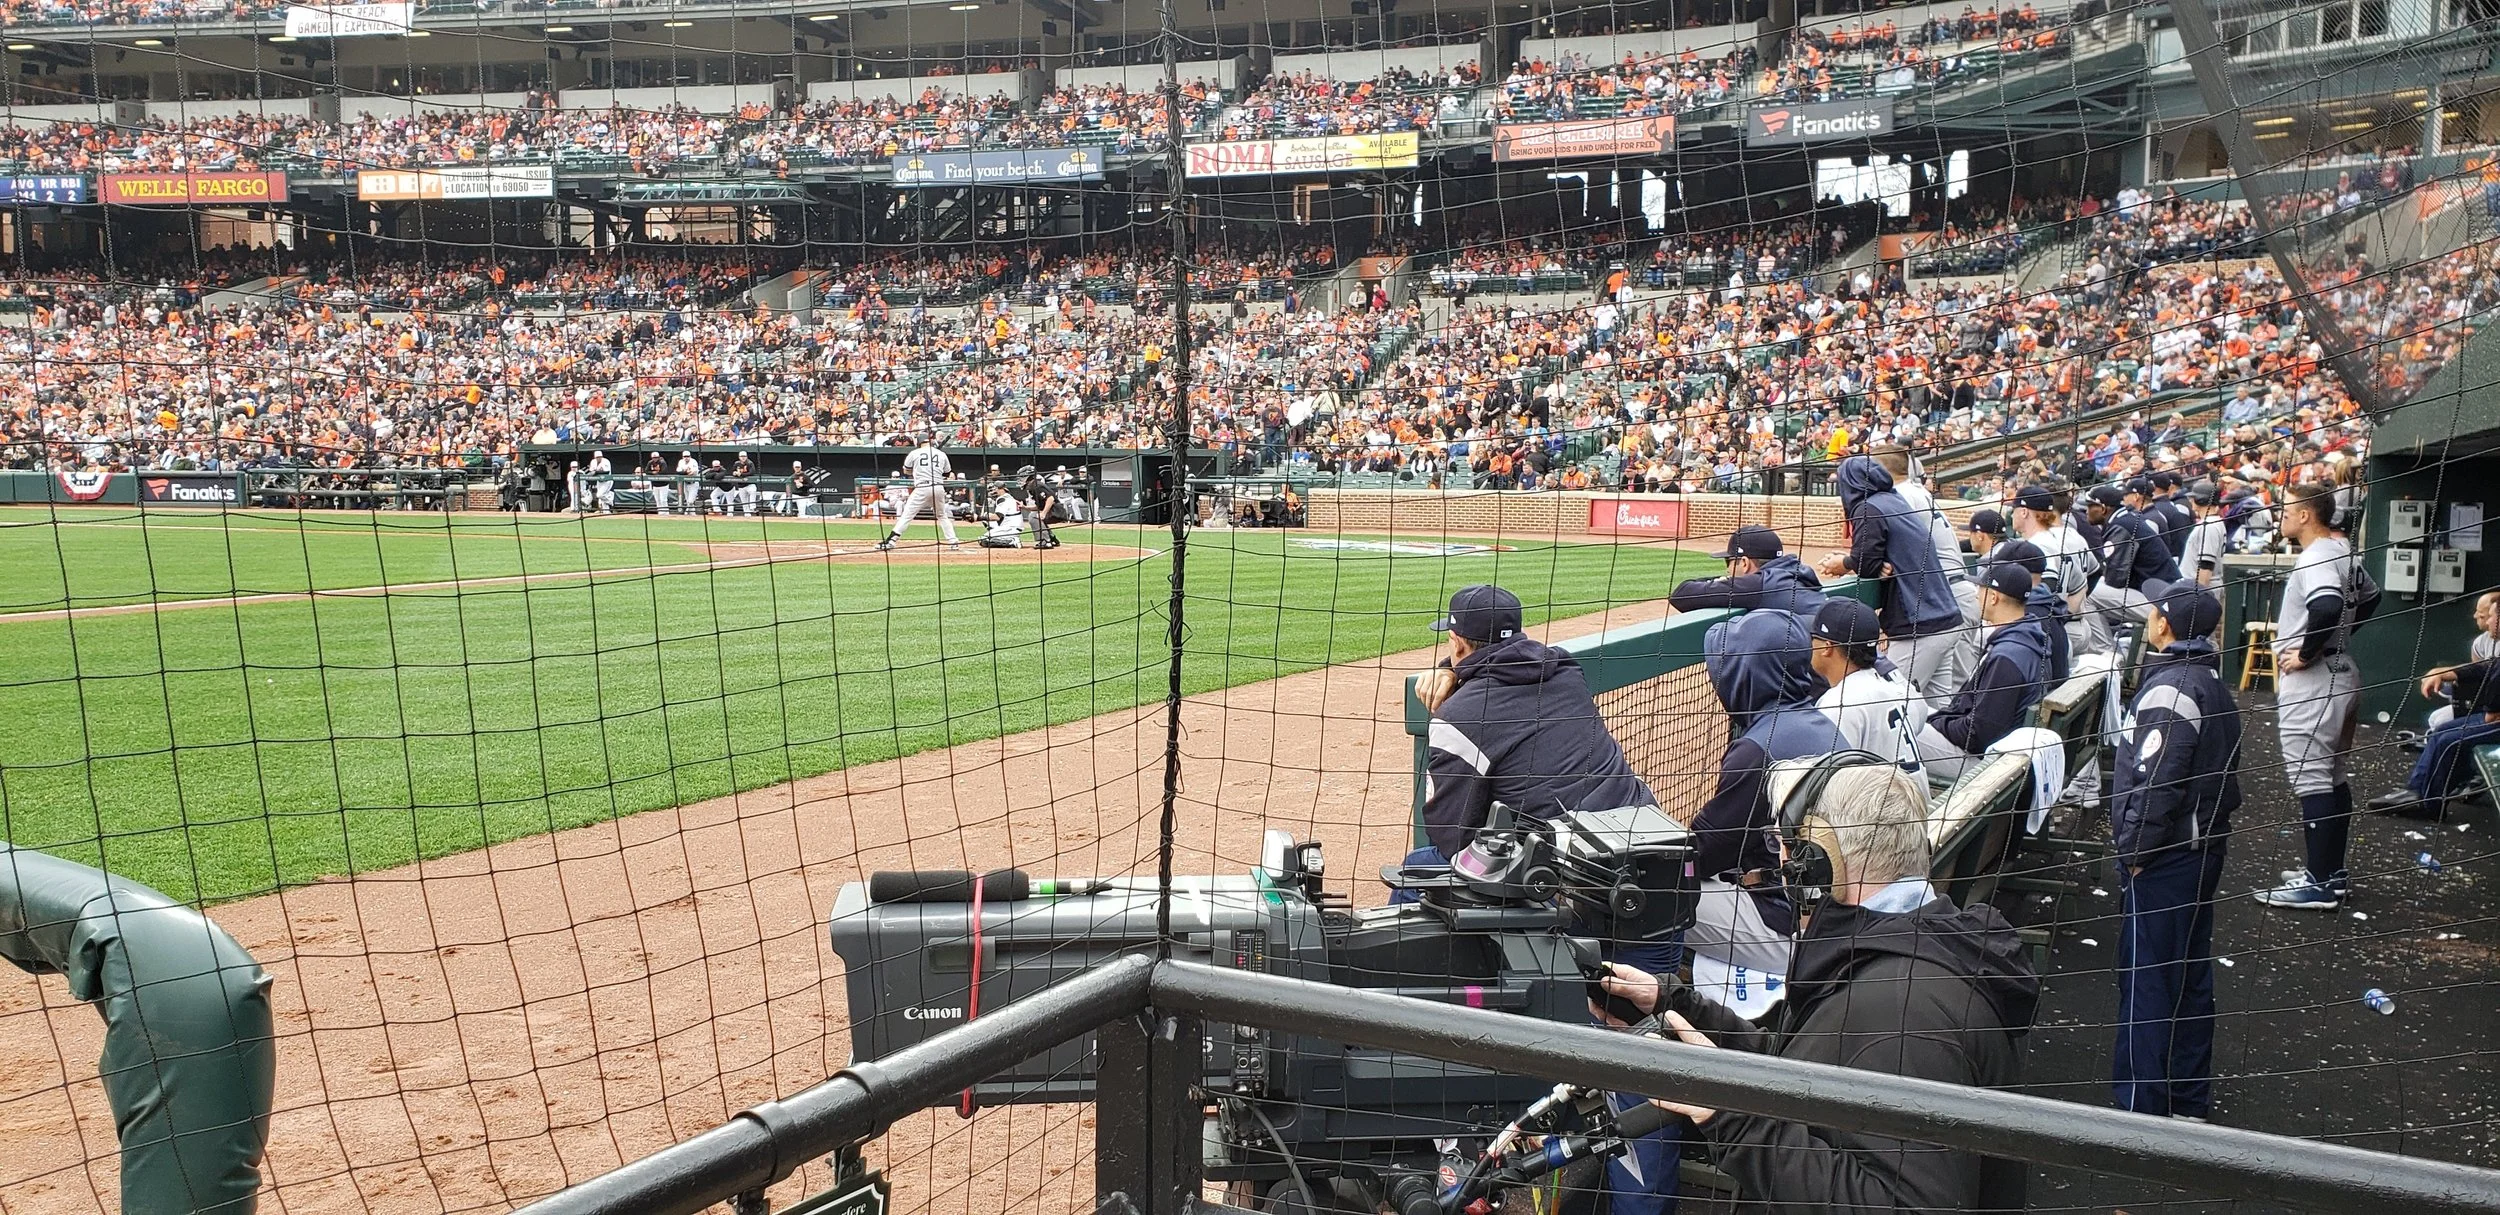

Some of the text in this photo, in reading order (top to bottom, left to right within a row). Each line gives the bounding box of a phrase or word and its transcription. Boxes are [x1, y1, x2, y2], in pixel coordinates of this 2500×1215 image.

[1792, 109, 1881, 136] Fanatics
[1369, 139, 1407, 148] AVAILABLE
[1190, 143, 1278, 175] ROMA
[1285, 153, 1353, 170] SAUSAGE
[945, 162, 973, 178] Find
[976, 165, 1003, 181] your
[10, 177, 81, 190] AVG HR RBI
[117, 178, 268, 197] WELLS FARGO
[451, 182, 489, 193] LOCATION
[46, 190, 55, 202] 2
[67, 189, 76, 202] 2
[919, 452, 940, 468] 24
[171, 483, 236, 501] Fanatics
[903, 1007, 962, 1020] Canon
